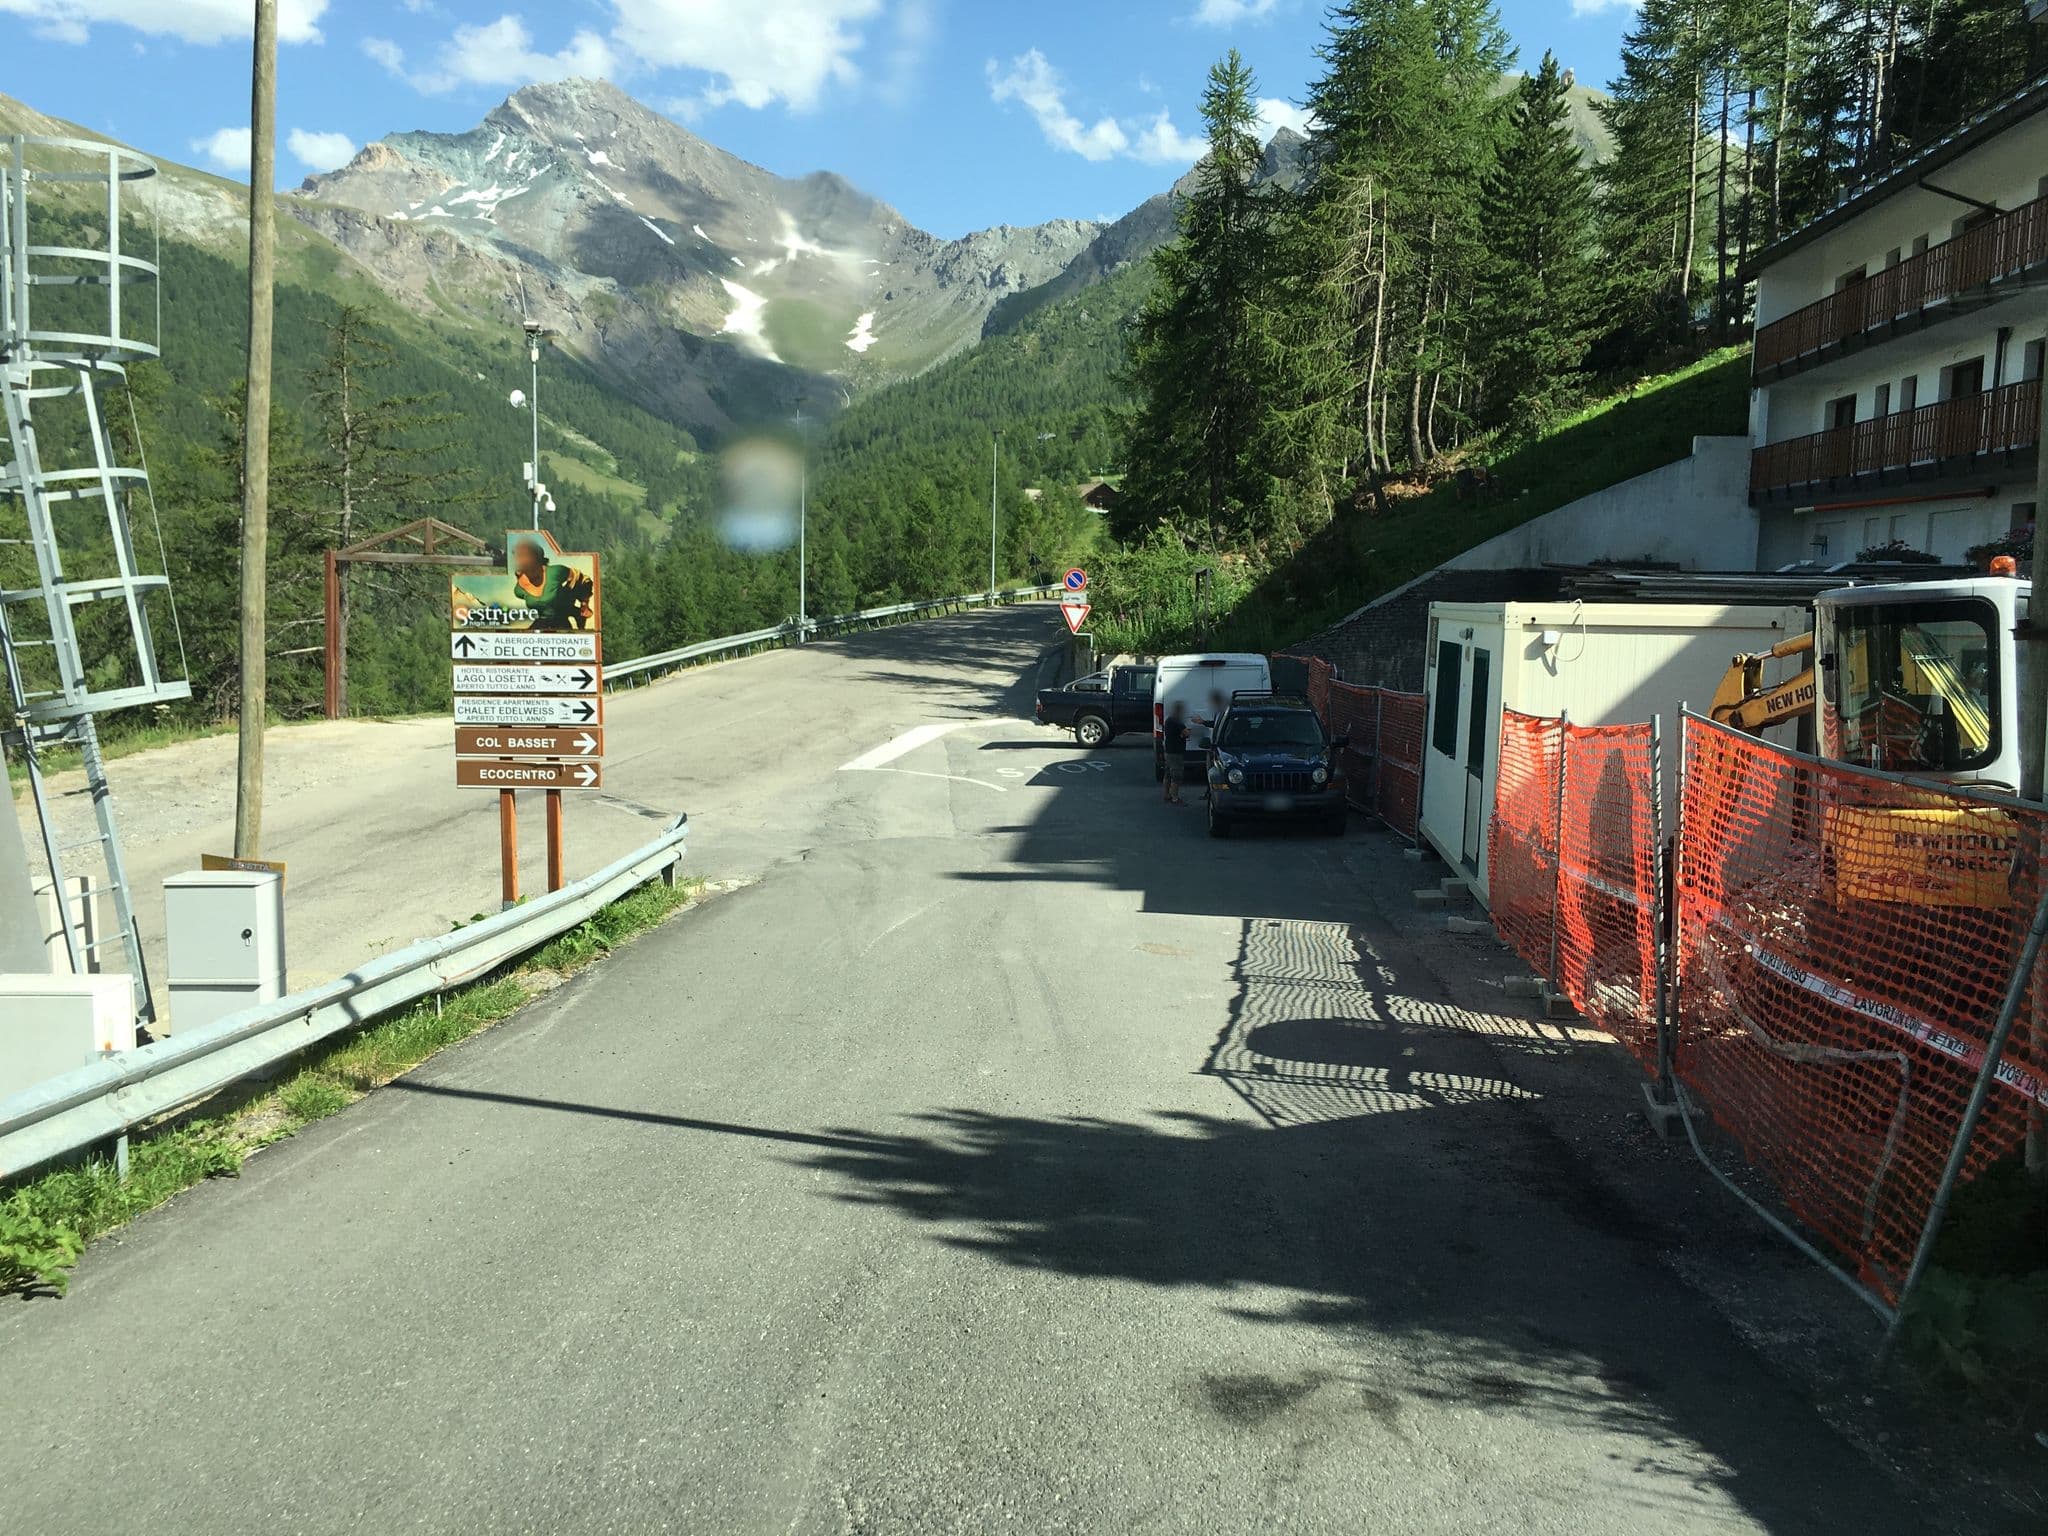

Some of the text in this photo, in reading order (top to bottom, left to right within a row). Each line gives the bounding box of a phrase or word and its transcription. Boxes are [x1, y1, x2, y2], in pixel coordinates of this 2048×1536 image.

[455, 606, 539, 626] Sestriere
[494, 637, 590, 645] ALBERGO-RISTORANTE
[494, 646, 519, 657] DEL
[522, 646, 576, 657] CENTRO
[456, 674, 535, 683] LAGO LOSETTA
[1766, 683, 1816, 714] NEW HO
[457, 706, 555, 716] CHALET EDELWEISS
[476, 737, 557, 748] COL BASSET
[479, 769, 556, 780] ECOCENTRO
[995, 760, 1112, 779] STOP
